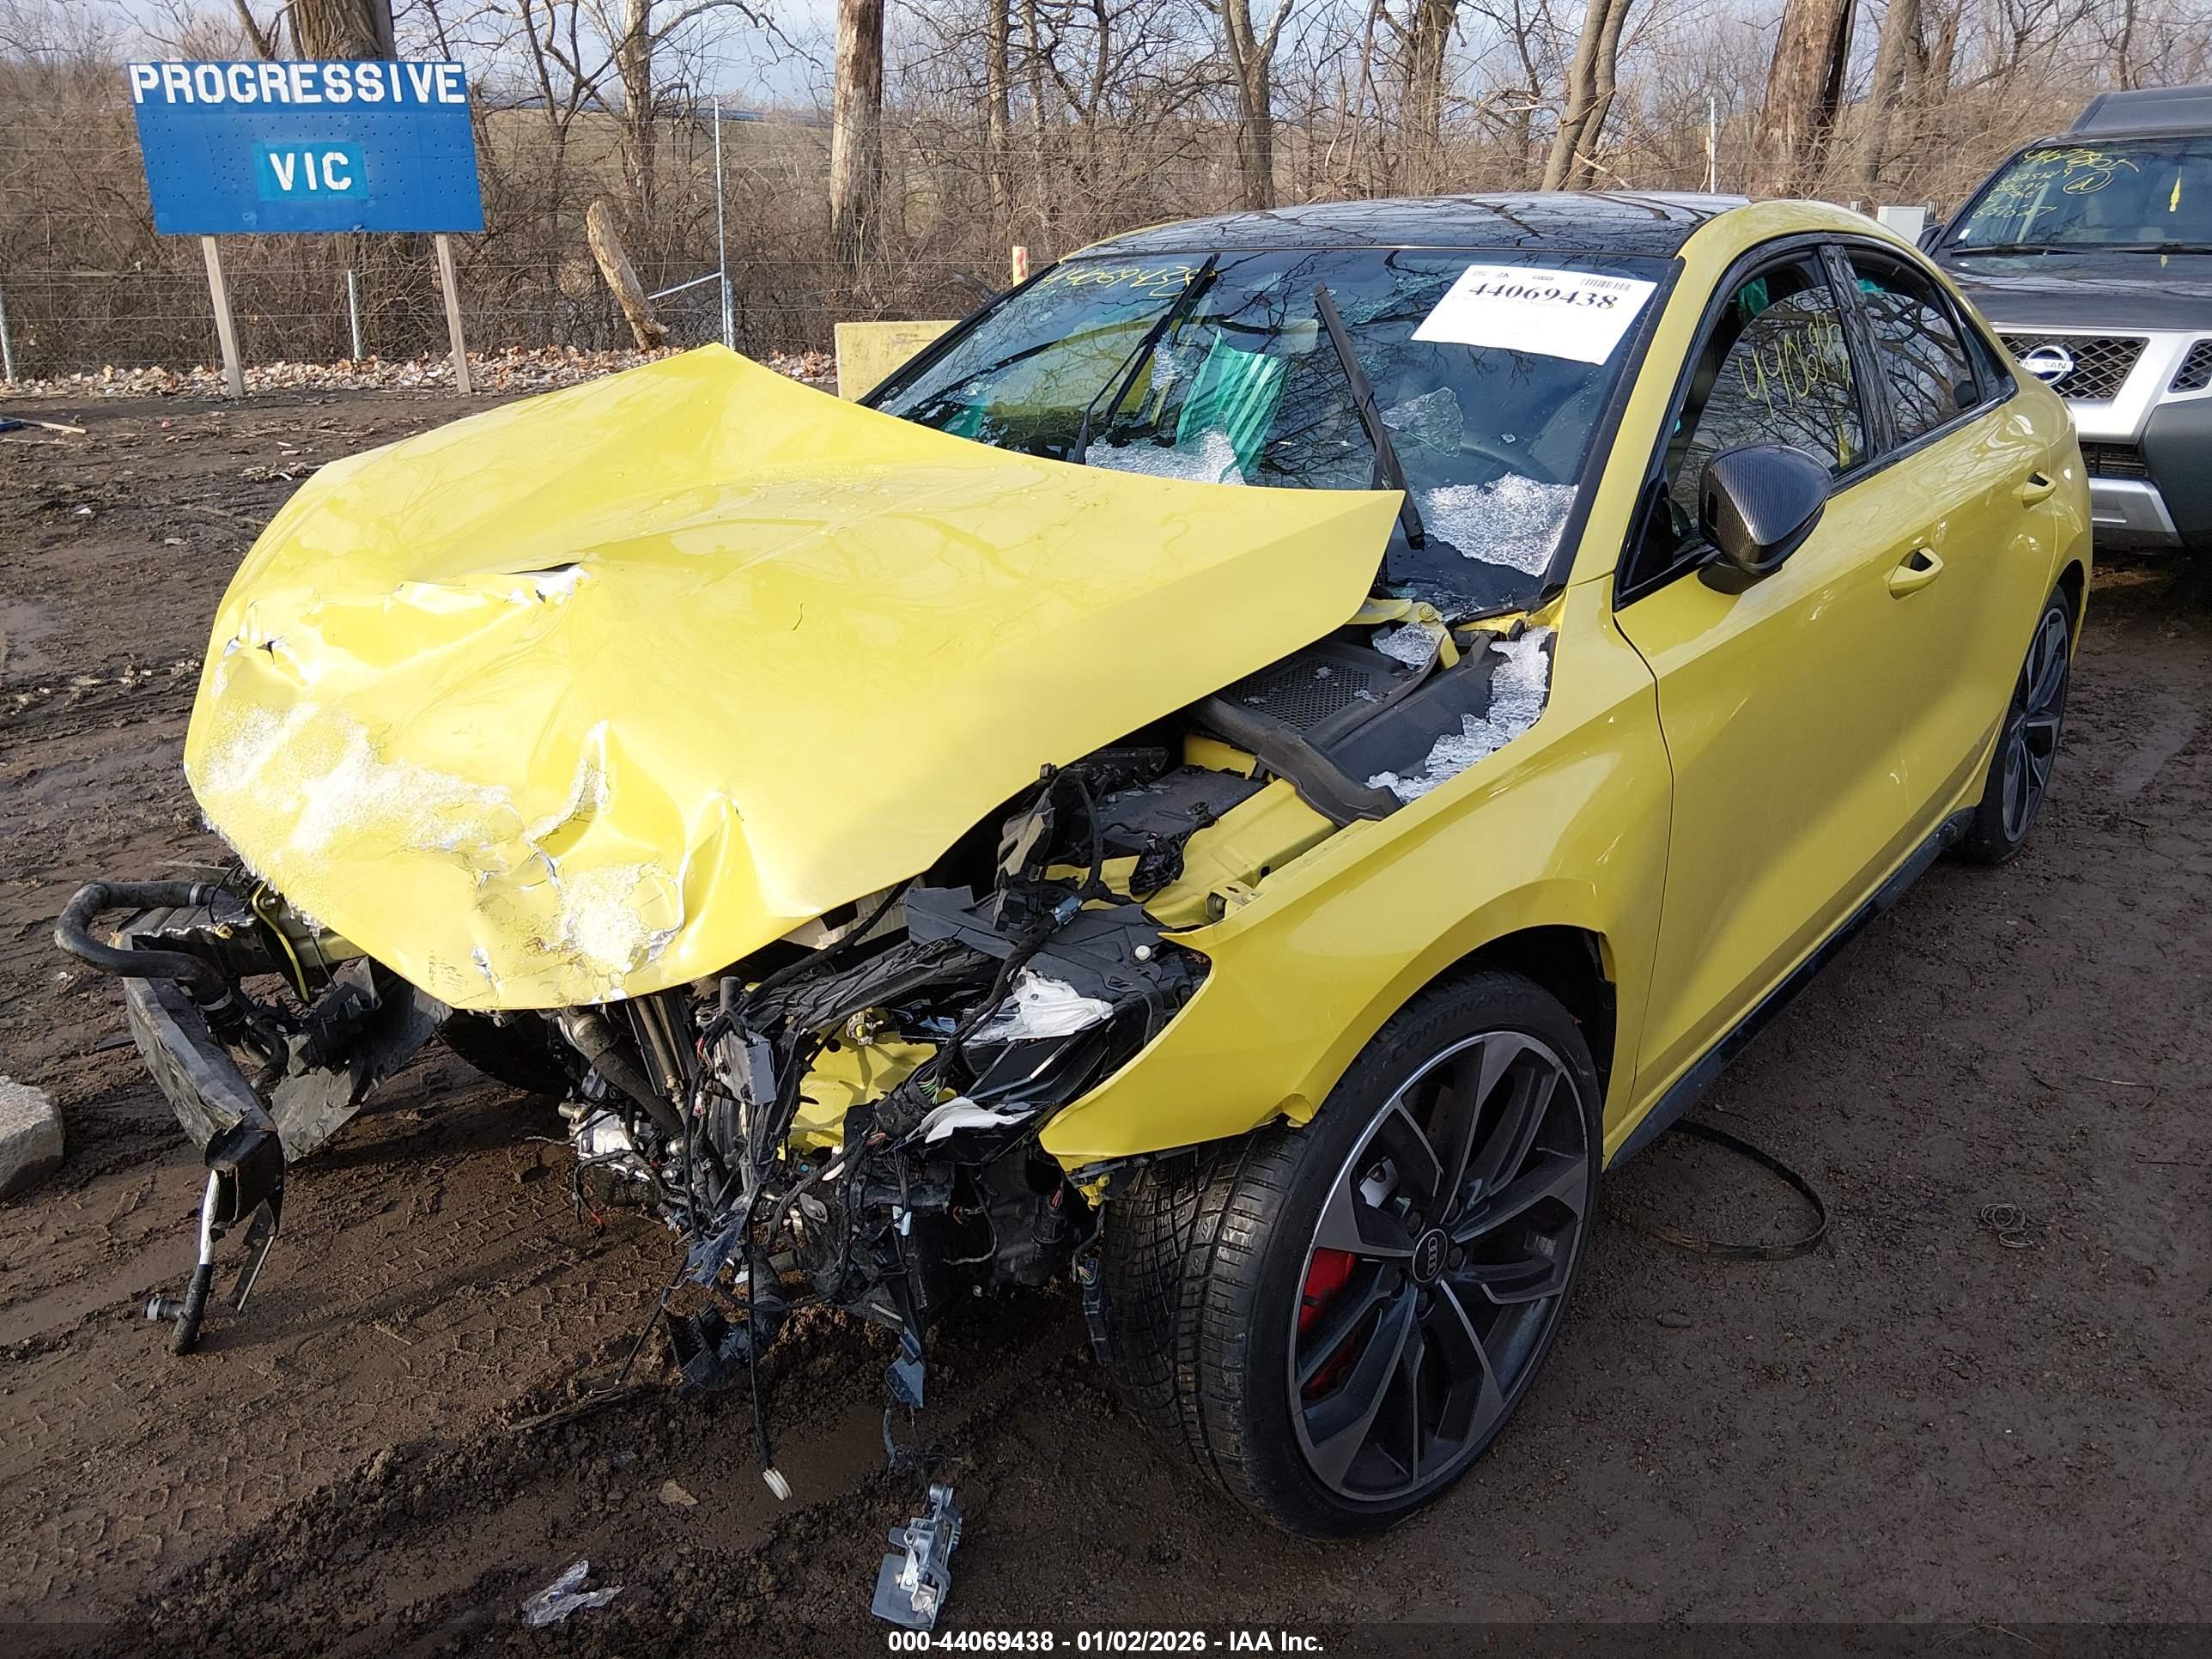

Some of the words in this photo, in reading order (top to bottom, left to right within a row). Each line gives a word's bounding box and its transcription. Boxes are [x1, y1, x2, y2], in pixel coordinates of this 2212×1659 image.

[129, 63, 466, 104] PROGRESSIVE
[270, 151, 352, 191] VIC
[1468, 283, 1620, 310] 44069438
[2023, 360, 2068, 371] NISAN
